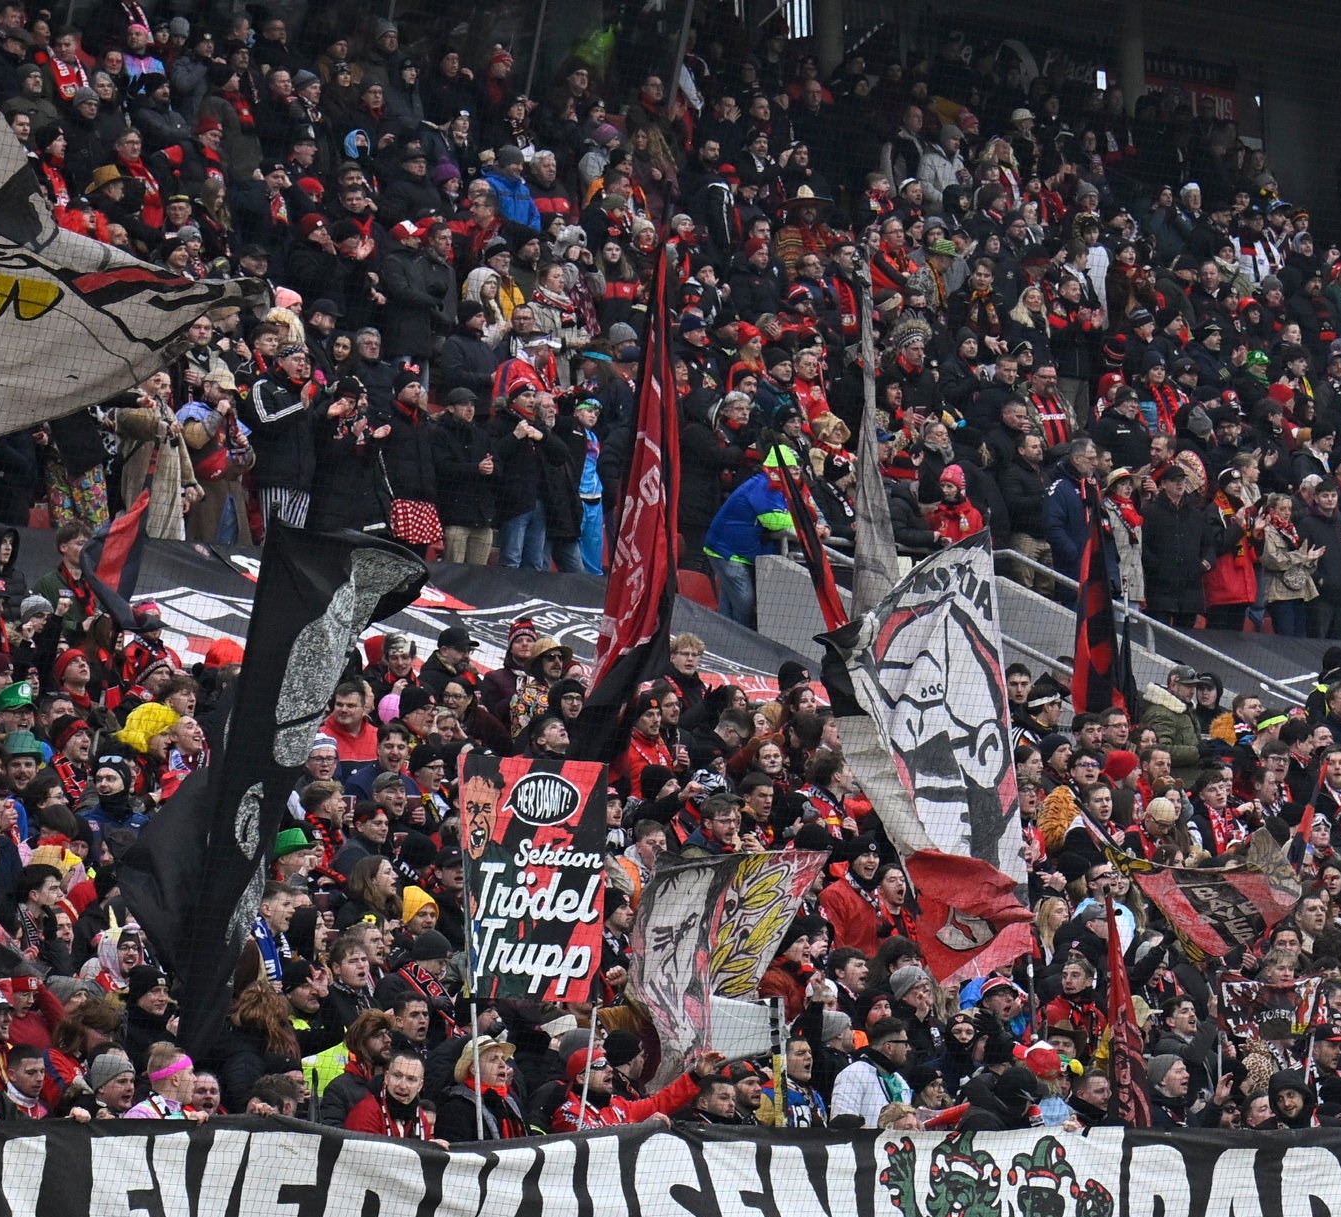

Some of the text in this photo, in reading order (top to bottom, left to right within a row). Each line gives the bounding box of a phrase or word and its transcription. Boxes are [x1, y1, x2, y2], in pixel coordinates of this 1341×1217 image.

[514, 838, 604, 869] Sektion
[475, 861, 602, 924] Trödel
[476, 918, 592, 996] Trupp
